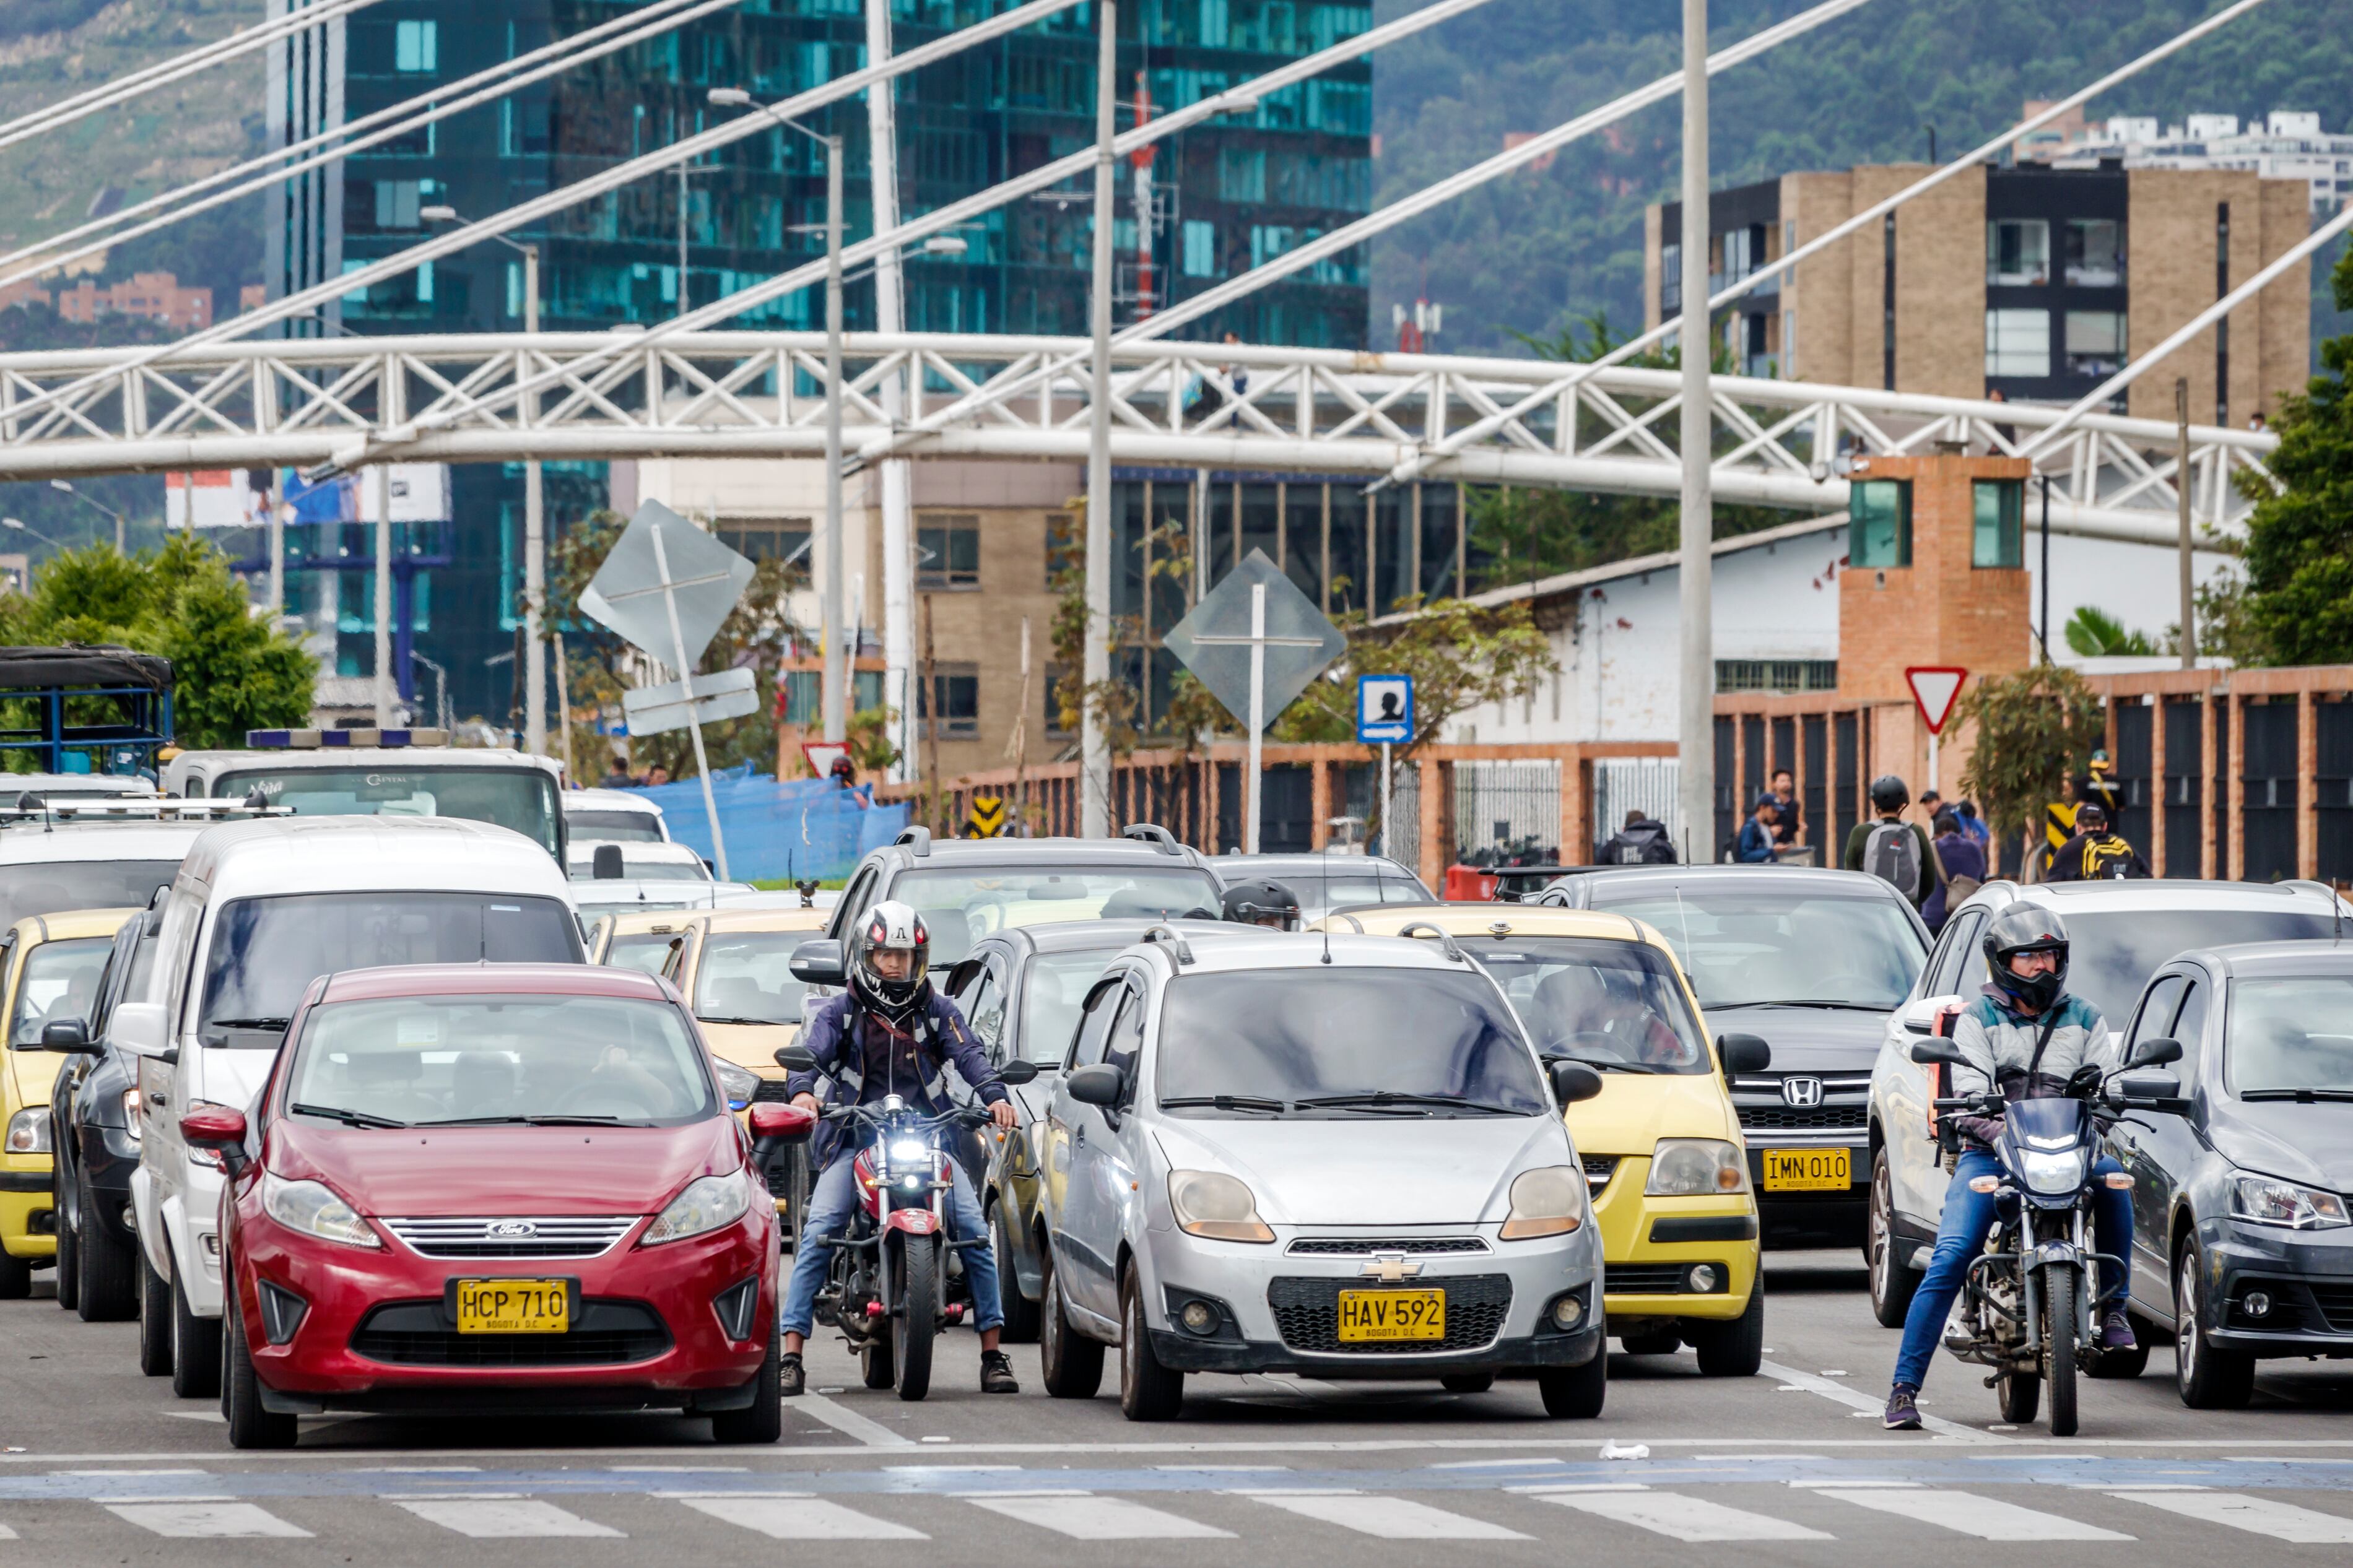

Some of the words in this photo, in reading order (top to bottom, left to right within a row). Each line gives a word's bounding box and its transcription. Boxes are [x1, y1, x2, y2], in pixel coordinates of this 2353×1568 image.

[367, 773, 407, 786] CAPITAL
[1770, 1157, 1804, 1179] IMN
[1811, 1156, 1846, 1178] 010
[498, 1223, 524, 1234] Ford
[463, 1291, 508, 1318] HCP
[517, 1291, 562, 1317] 710
[1344, 1301, 1387, 1327] HAV
[1396, 1300, 1440, 1325] 592
[487, 1320, 519, 1328] BOGOTA
